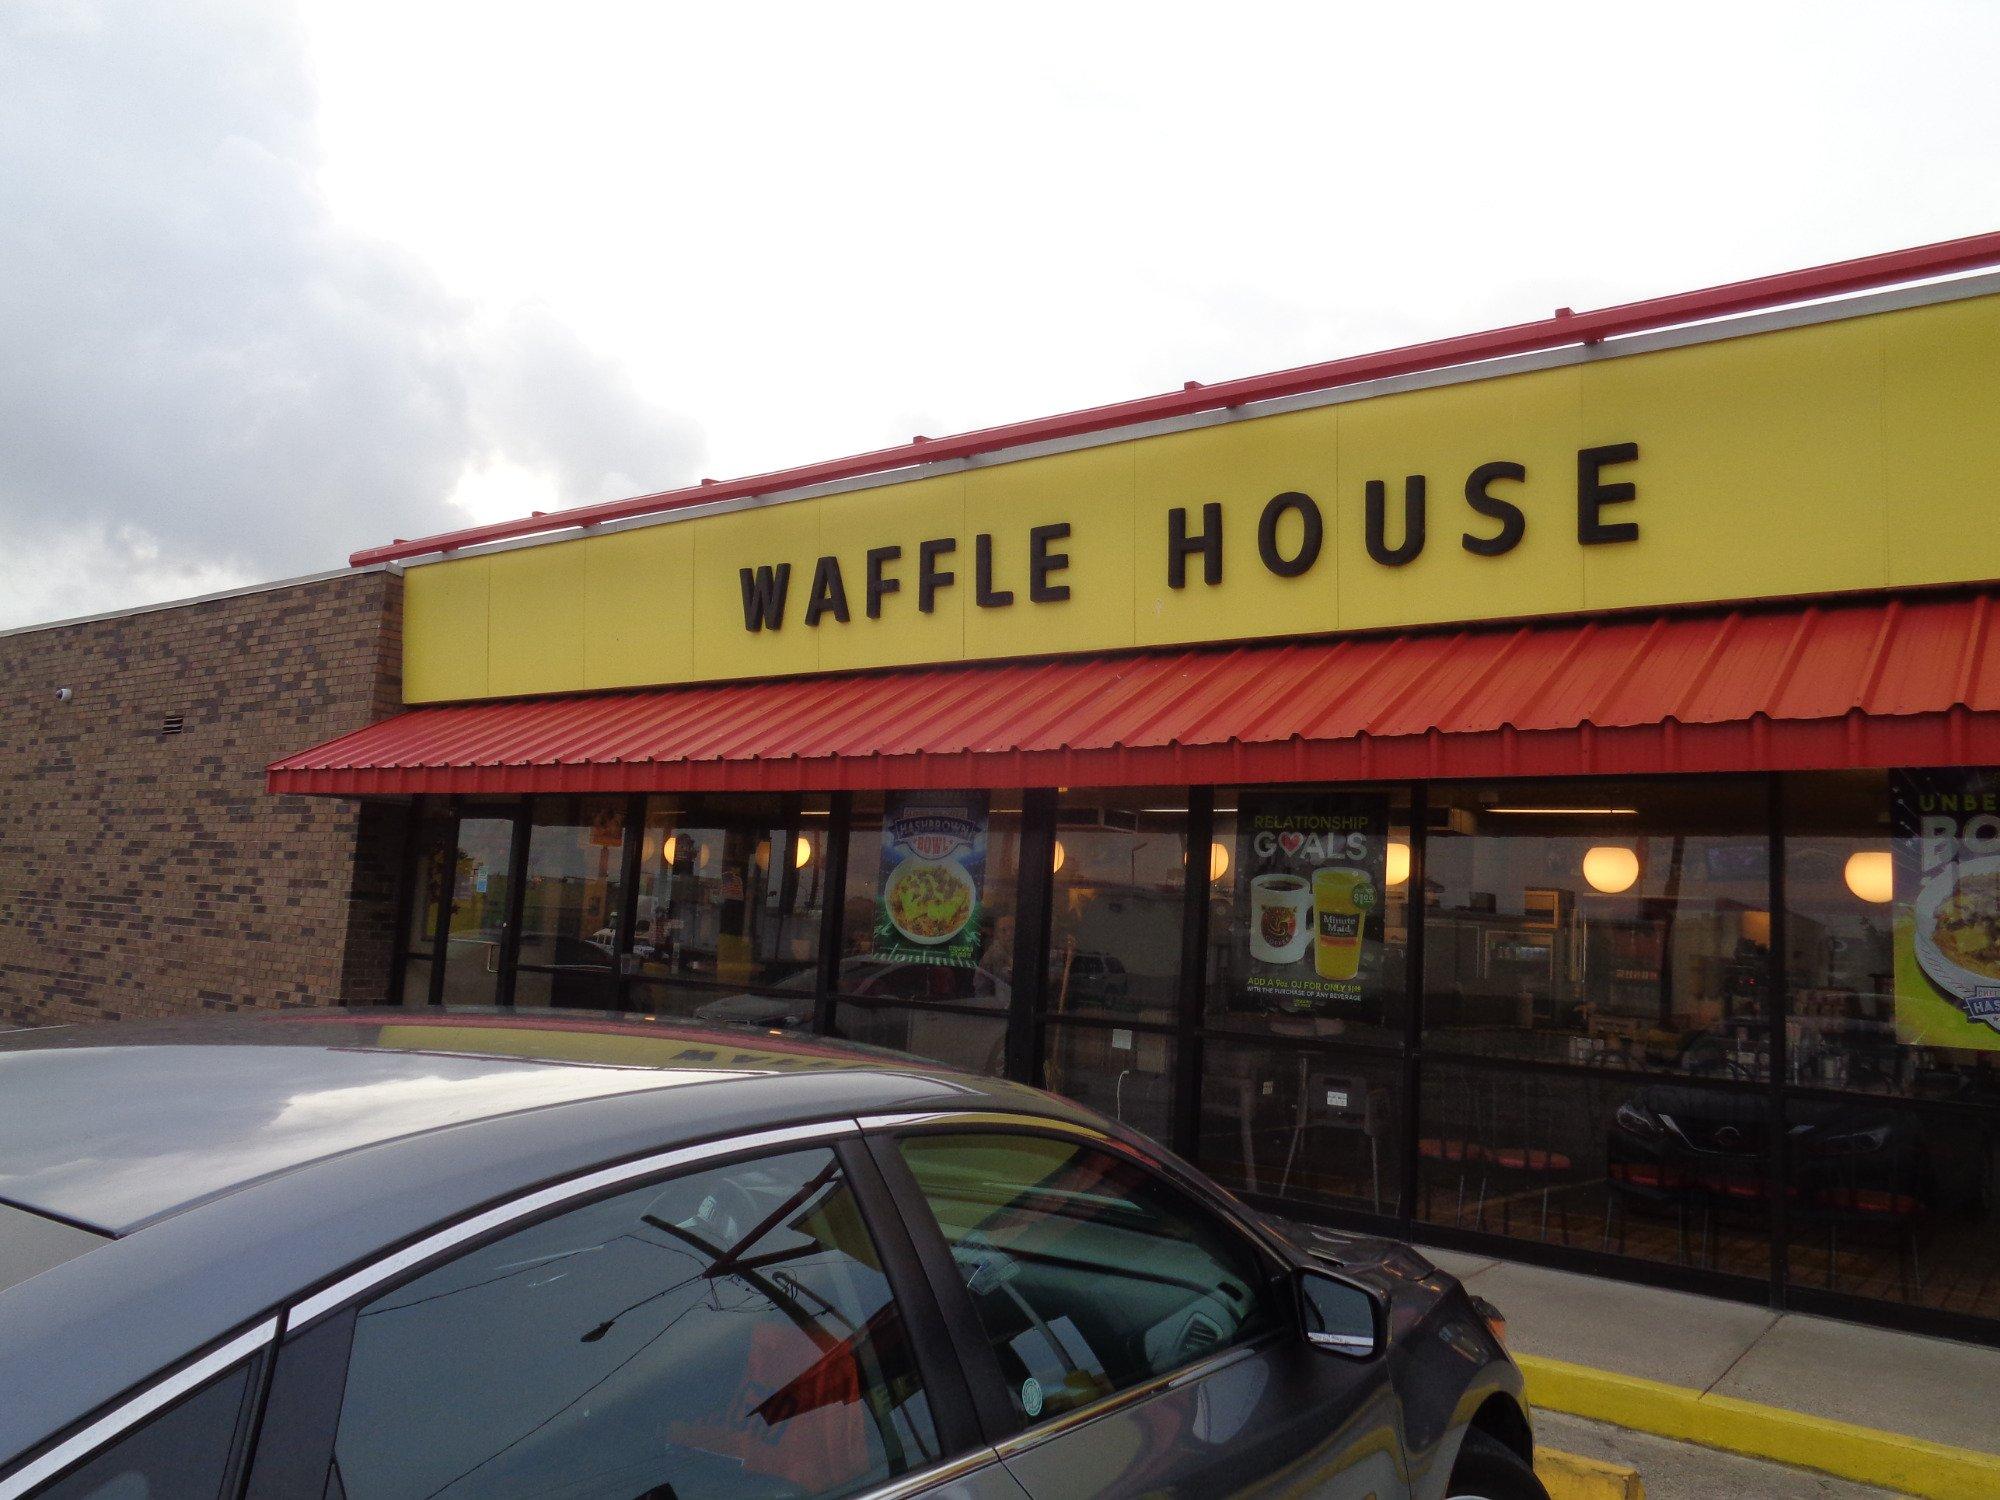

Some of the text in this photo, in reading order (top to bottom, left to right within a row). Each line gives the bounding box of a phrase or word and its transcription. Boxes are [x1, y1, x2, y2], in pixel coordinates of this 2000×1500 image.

[739, 442, 1640, 632] WAFFLE HOUSE
[1254, 815, 1369, 830] RELATIONSHIP
[1323, 914, 1356, 924] Minute
[1327, 924, 1351, 933] Maid
[1247, 976, 1266, 986] ADD
[1267, 978, 1274, 986] A
[1304, 981, 1322, 991] FOR
[1323, 983, 1346, 992] ONLY
